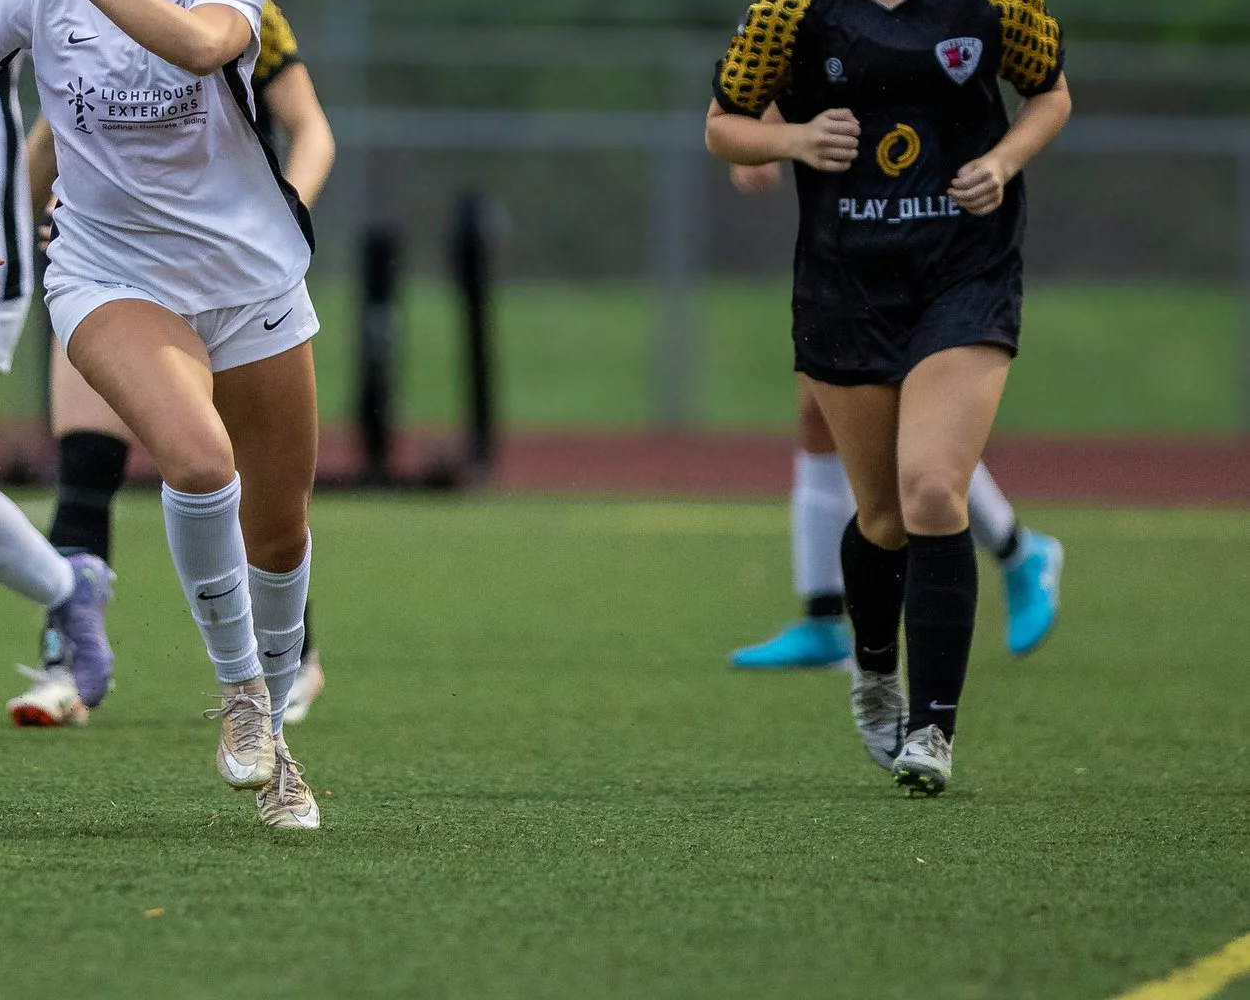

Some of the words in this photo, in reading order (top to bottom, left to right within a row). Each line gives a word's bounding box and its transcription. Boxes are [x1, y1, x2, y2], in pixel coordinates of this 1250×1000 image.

[101, 80, 202, 101] LIGHTHOUSE
[108, 98, 198, 117] EXTERIORS
[102, 123, 133, 131] Roofing
[184, 116, 207, 126] Siding
[838, 195, 961, 223] PLAY_OLLIE
